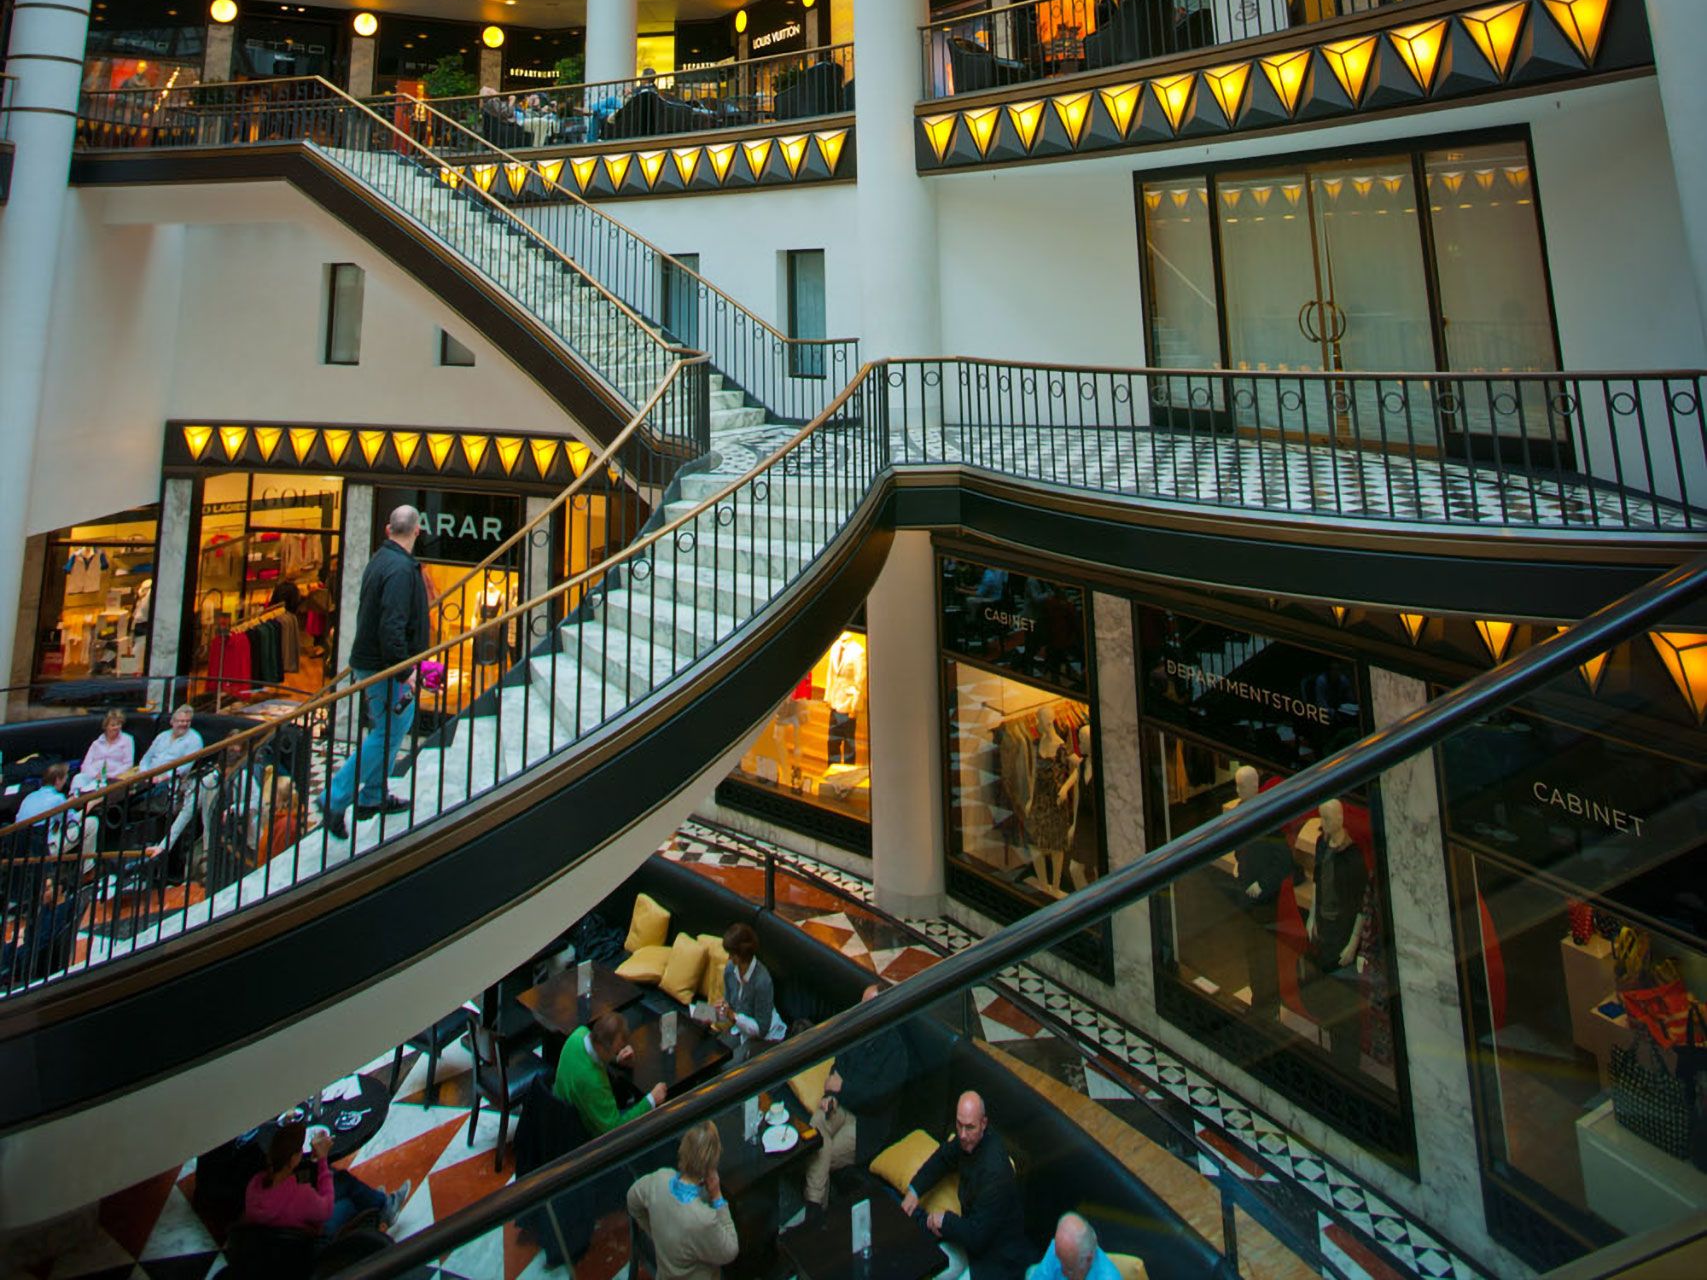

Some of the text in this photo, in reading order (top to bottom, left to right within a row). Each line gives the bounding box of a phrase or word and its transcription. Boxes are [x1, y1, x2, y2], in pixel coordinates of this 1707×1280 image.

[752, 24, 801, 50] LOUIS VUITTON
[417, 511, 502, 541] ARAR
[984, 607, 1037, 632] CABINET
[1166, 659, 1331, 726] DEPARTMENTSTORE
[1533, 781, 1645, 837] CABINET
